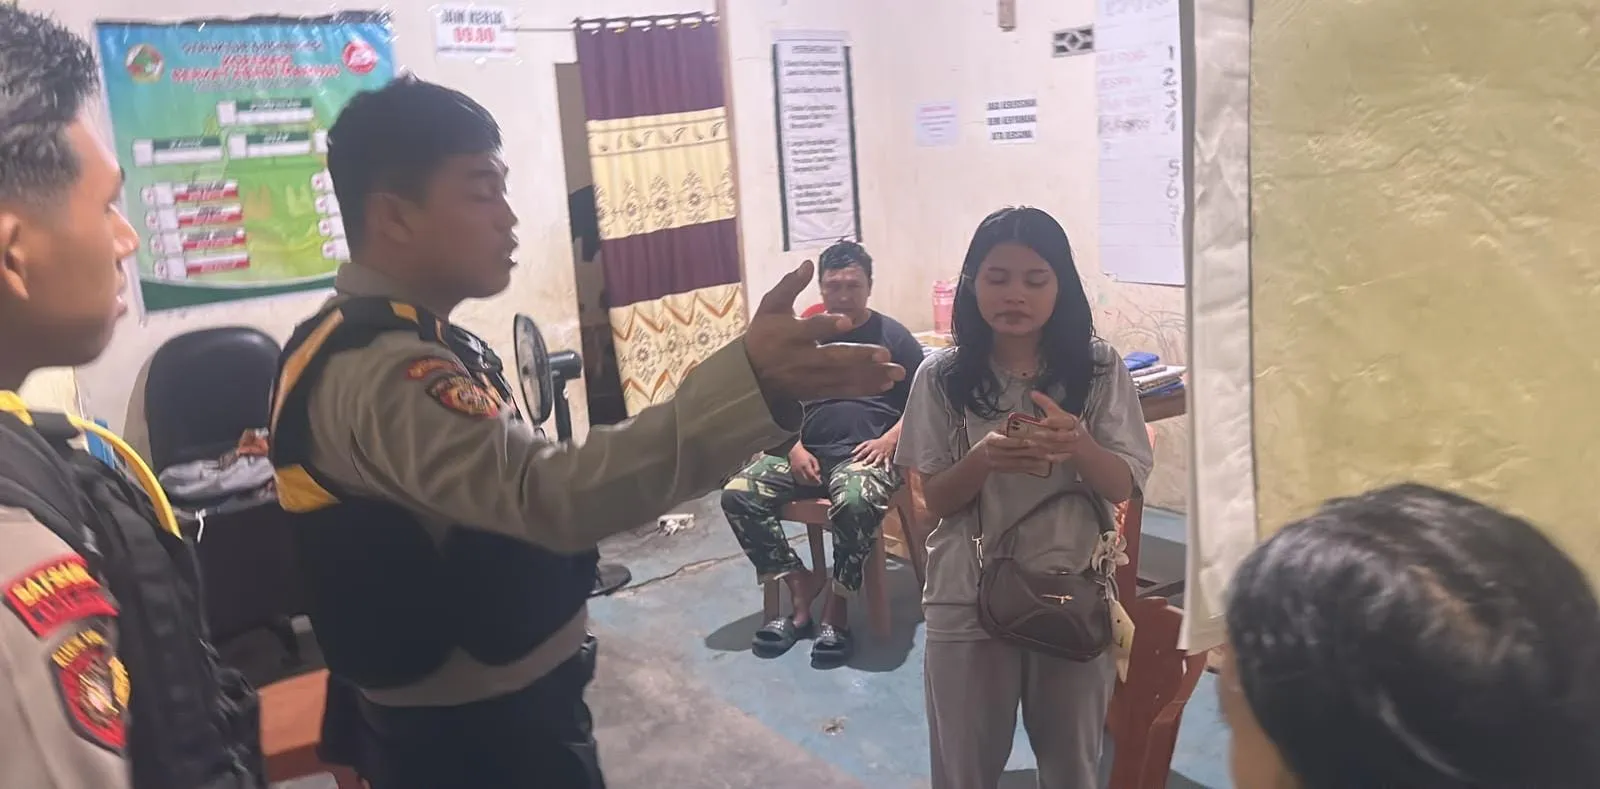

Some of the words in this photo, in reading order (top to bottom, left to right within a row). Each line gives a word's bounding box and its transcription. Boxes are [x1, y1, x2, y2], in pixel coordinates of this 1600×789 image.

[1168, 45, 1174, 60] 1
[1162, 67, 1177, 86] 2
[1165, 90, 1177, 108] 3
[1168, 159, 1180, 178] 5
